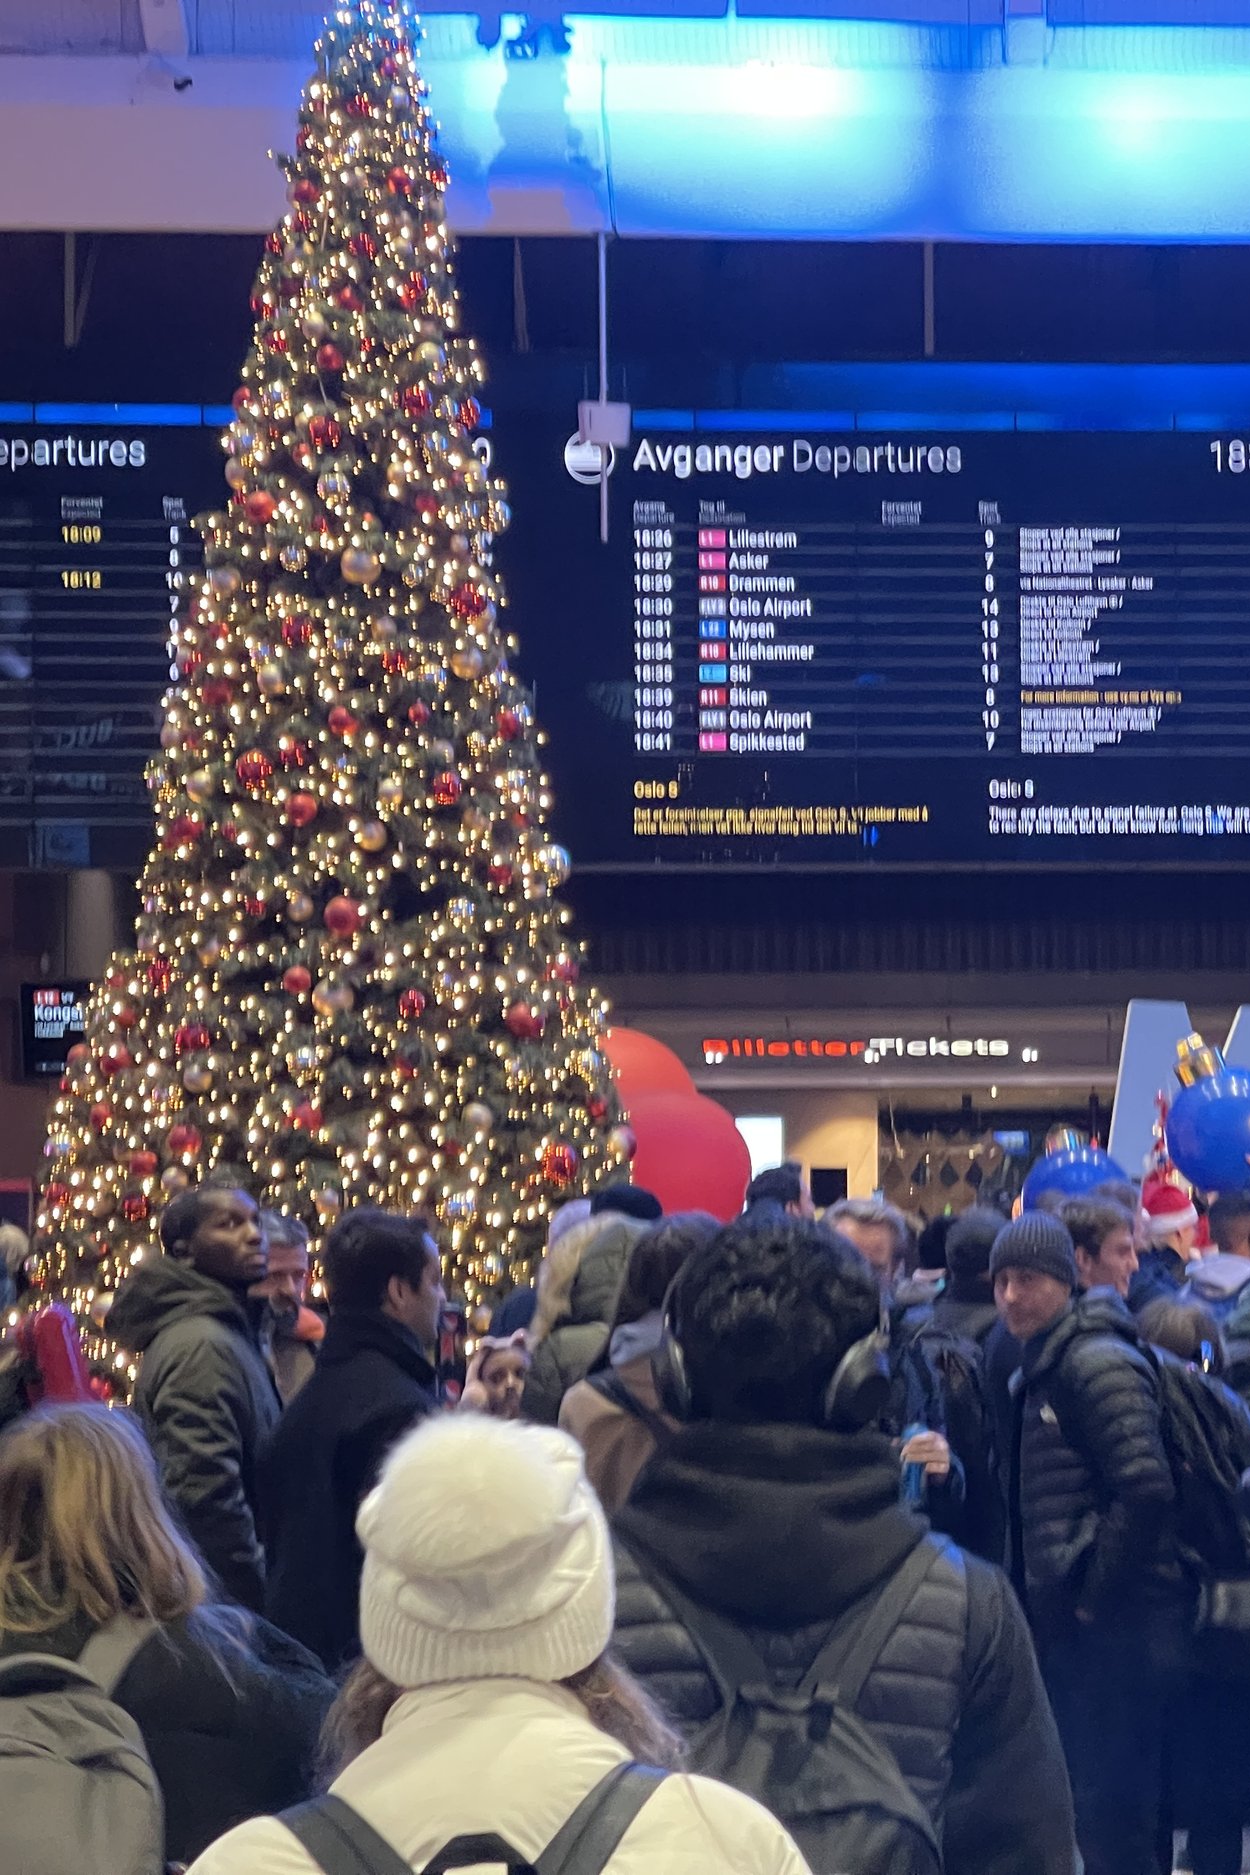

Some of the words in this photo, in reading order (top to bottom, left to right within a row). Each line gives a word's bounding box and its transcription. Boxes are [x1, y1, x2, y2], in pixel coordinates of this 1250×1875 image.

[633, 438, 784, 479] Avganger
[793, 439, 962, 479] Departures
[634, 780, 665, 799] Oslo
[703, 1038, 865, 1057] Billetter
[869, 1037, 1009, 1057] Tickets
